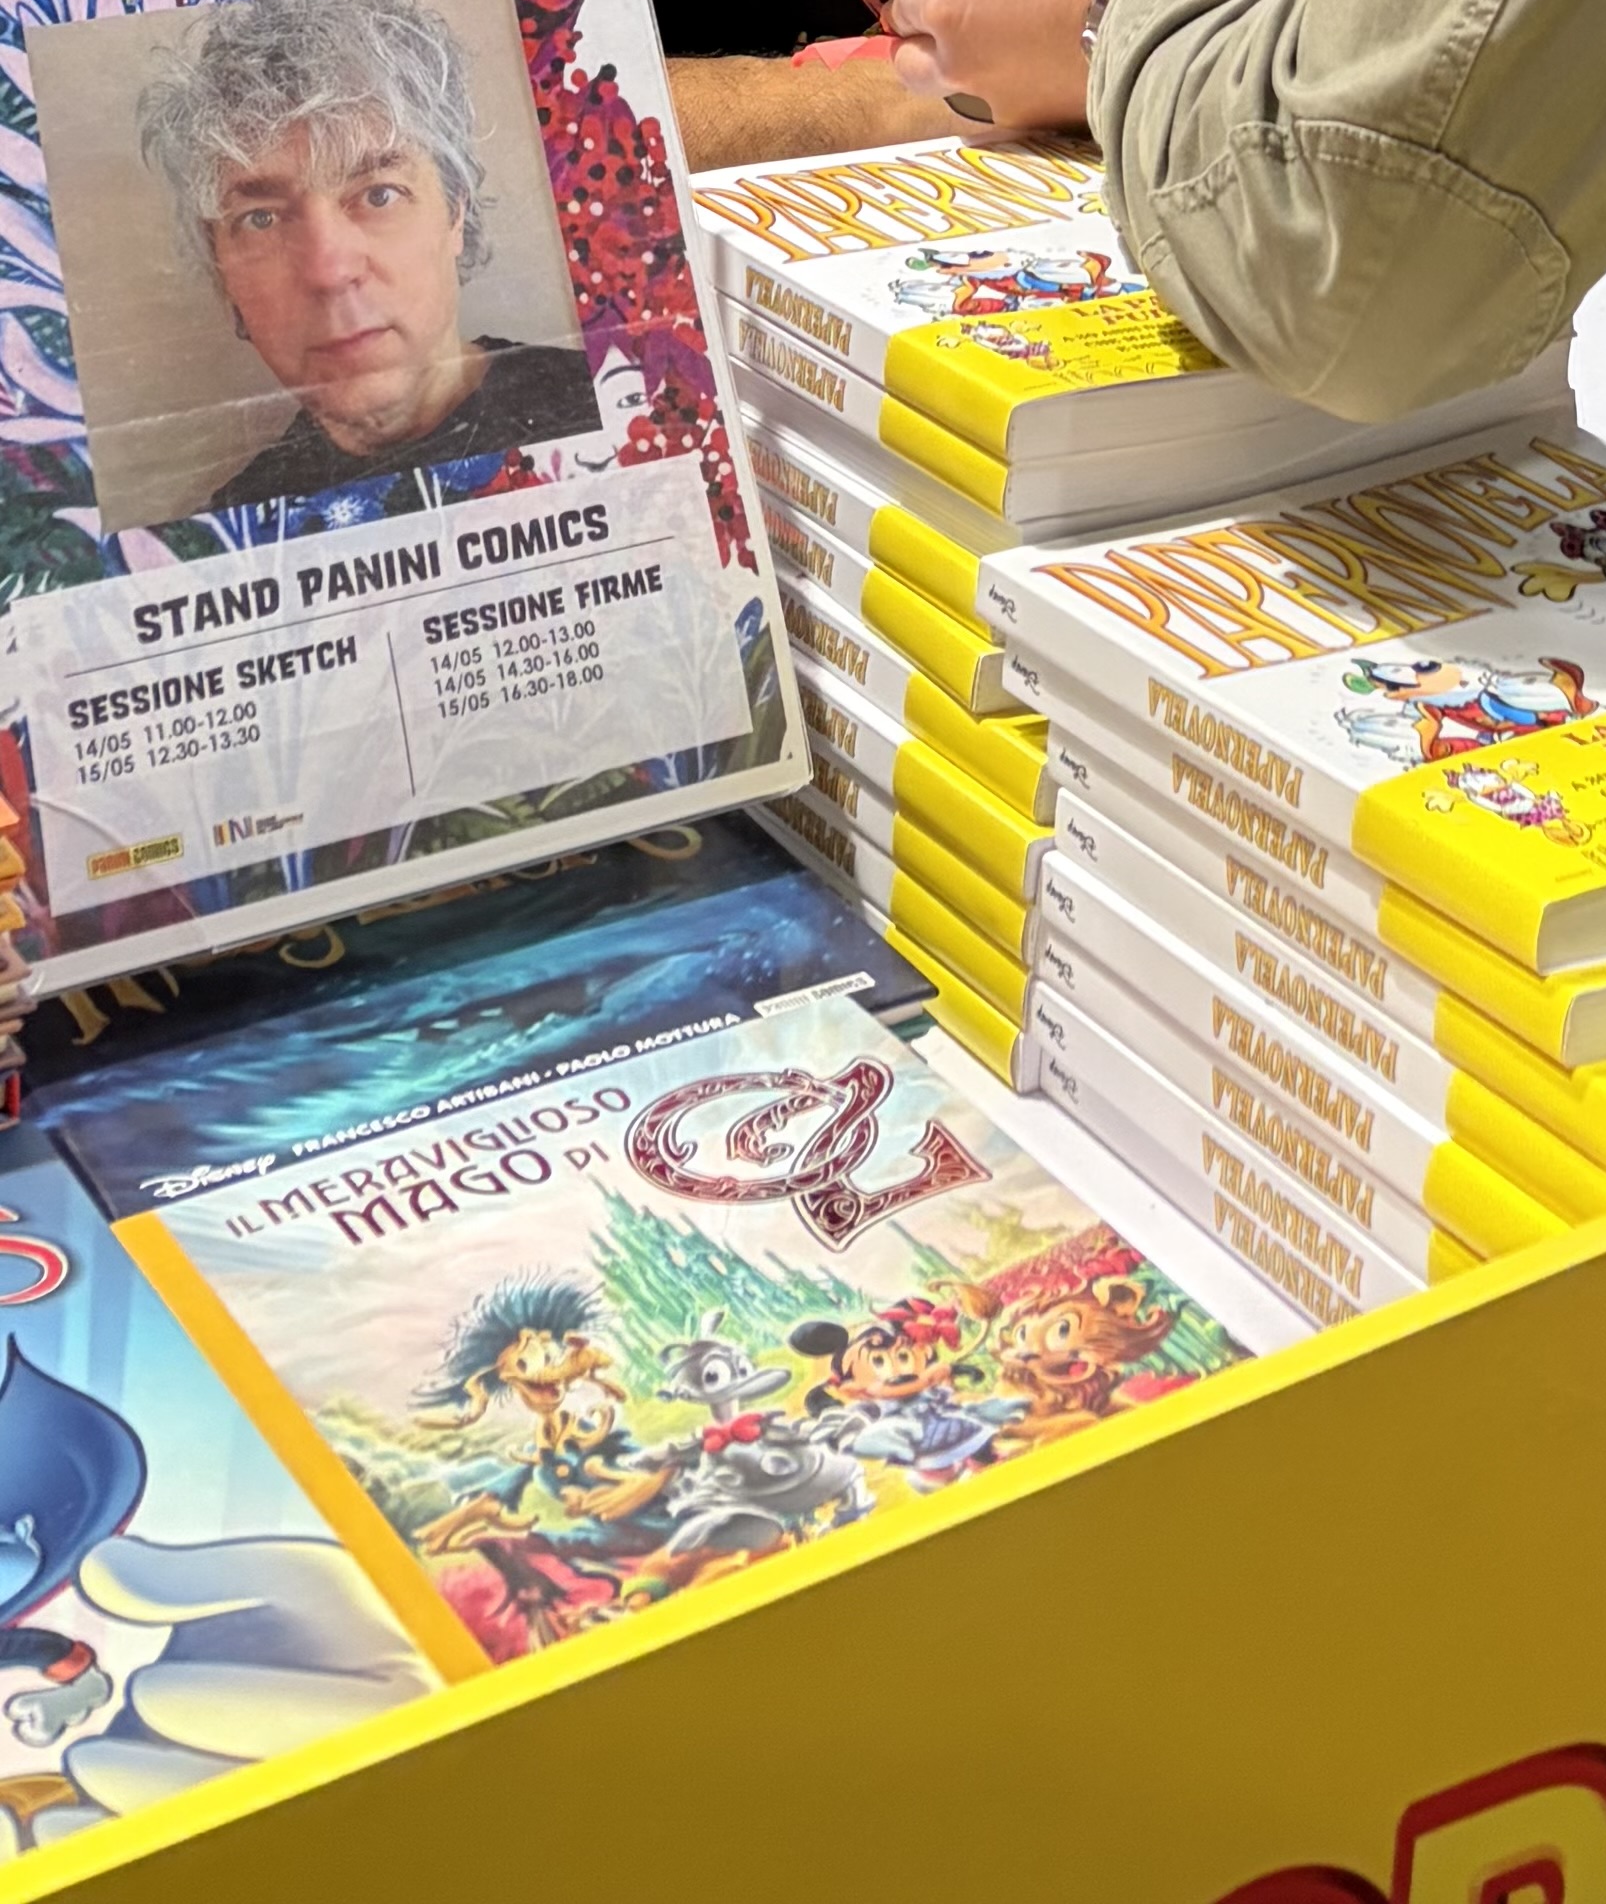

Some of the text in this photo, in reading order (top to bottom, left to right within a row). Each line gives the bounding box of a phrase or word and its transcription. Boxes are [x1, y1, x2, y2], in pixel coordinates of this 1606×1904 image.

[132, 503, 610, 645] STAND PANINI COMICS
[422, 564, 664, 645] SESSIONE FIRME
[67, 635, 359, 731] SESSIONE SKETCH
[429, 619, 597, 674] 14/05 12.00-13.00
[433, 641, 601, 697] 14/05 14.30-16.00
[437, 663, 605, 720] 15/05 16.30-18.00
[74, 700, 257, 762] 14/05 11.00-12.00
[77, 724, 261, 785] 15/05 12.30-13.30
[1147, 676, 1304, 810] PAPERNOVELA
[1171, 750, 1329, 891] PAPERNOVELA
[1225, 852, 1390, 1002] PAPERNOVELA
[1211, 995, 1375, 1155] PAPERNOVELA
[1233, 929, 1400, 1084] PAPERNOVELA
[292, 1103, 431, 1157] FRANCESCO
[436, 1070, 541, 1114] ARTIBANI
[555, 1044, 631, 1078] PAOLO
[634, 1011, 743, 1055] MOTTURA
[1211, 1064, 1375, 1230] PAPERNOVELA
[225, 1087, 632, 1240] IL MERAVIGLIOSO
[329, 1141, 611, 1247] MAGO DI
[1200, 1131, 1365, 1301] PAPERNOVELA
